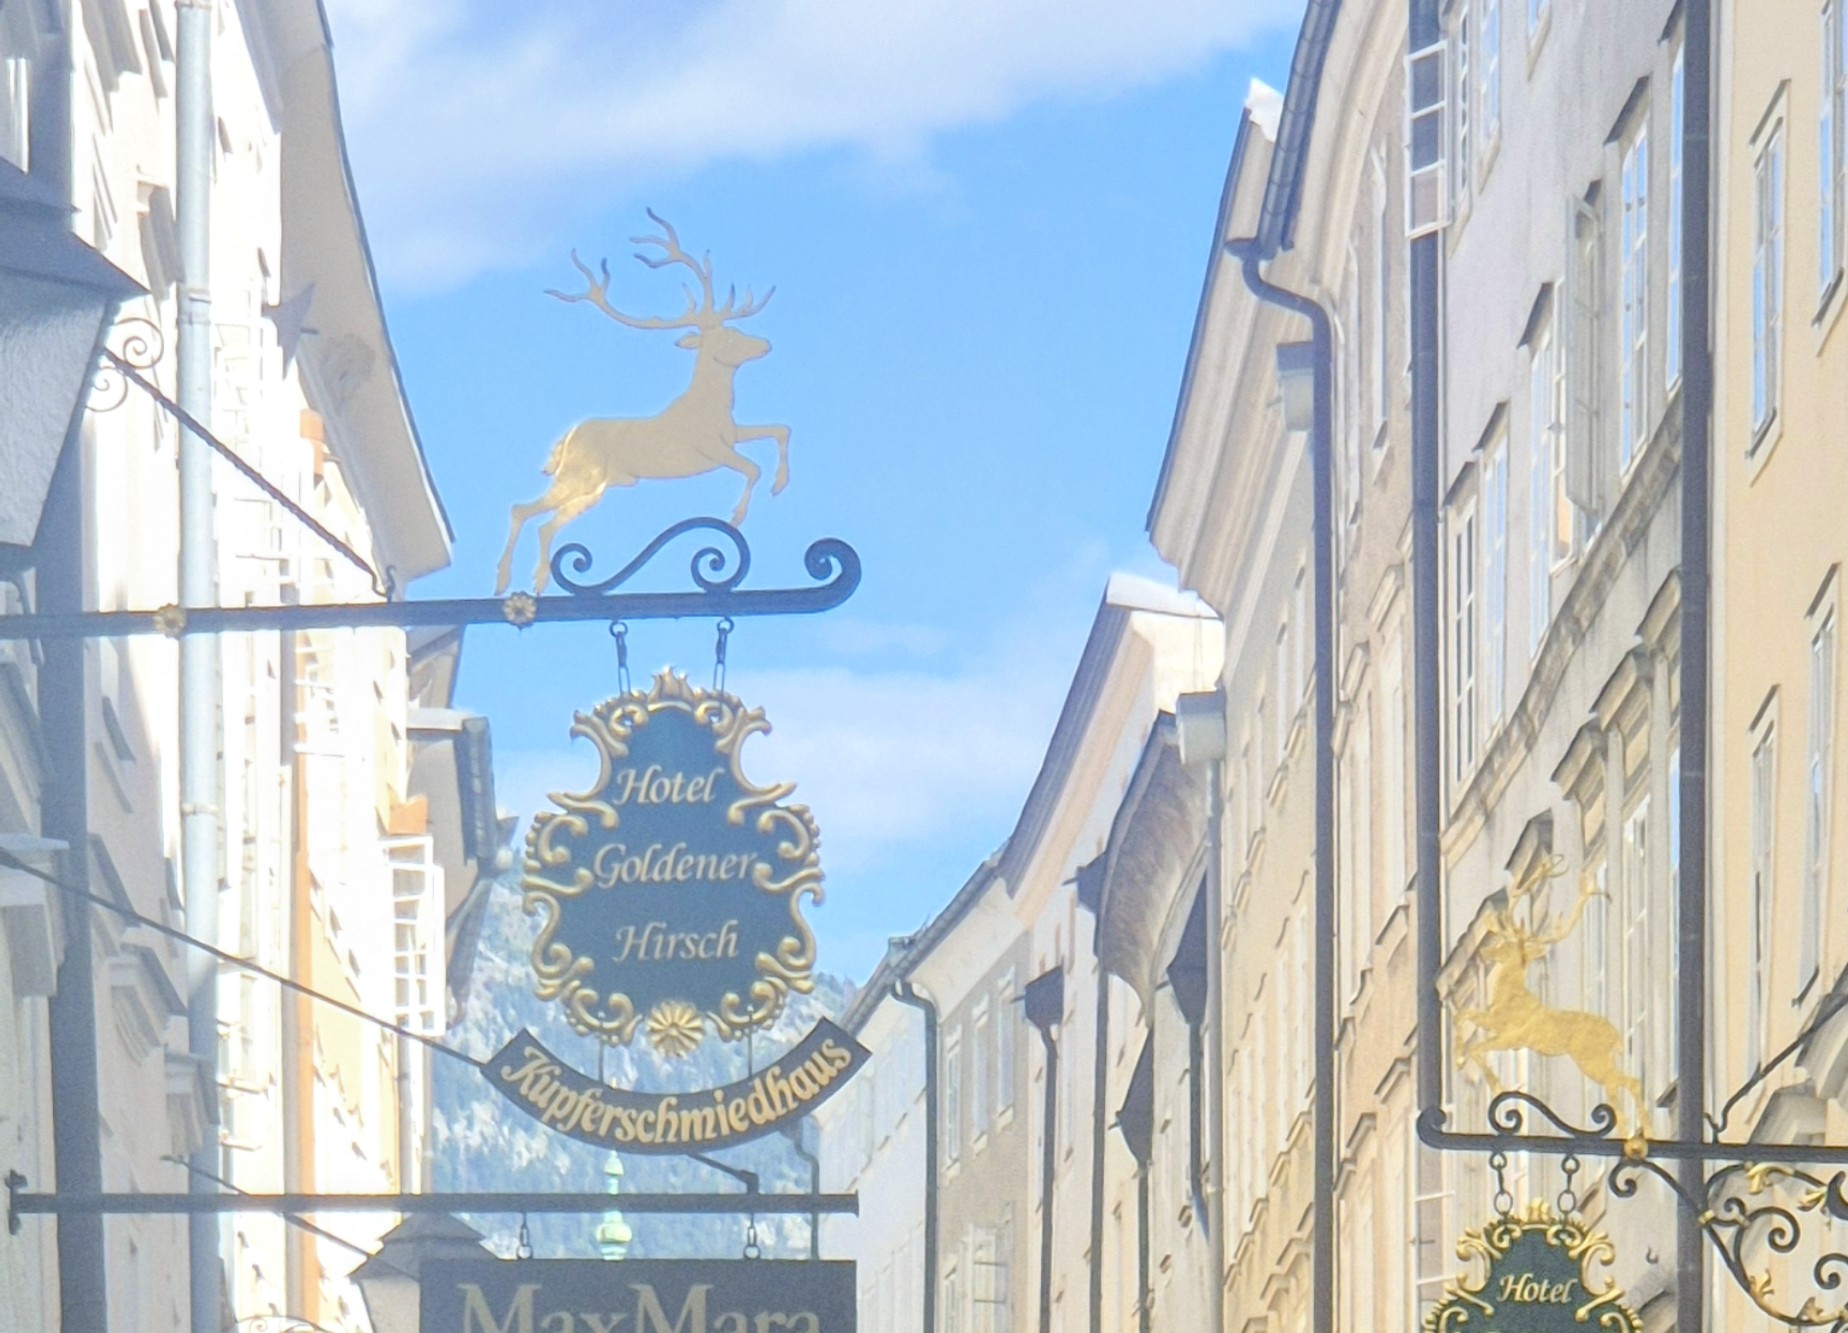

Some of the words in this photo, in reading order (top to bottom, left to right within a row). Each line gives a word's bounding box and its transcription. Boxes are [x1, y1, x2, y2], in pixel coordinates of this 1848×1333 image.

[614, 765, 724, 804] Hotel
[593, 843, 758, 888] Goldener
[612, 920, 739, 962] Hirsch
[501, 1036, 852, 1147] Kupferschmiedhaus
[1497, 1274, 1578, 1304] Hotel
